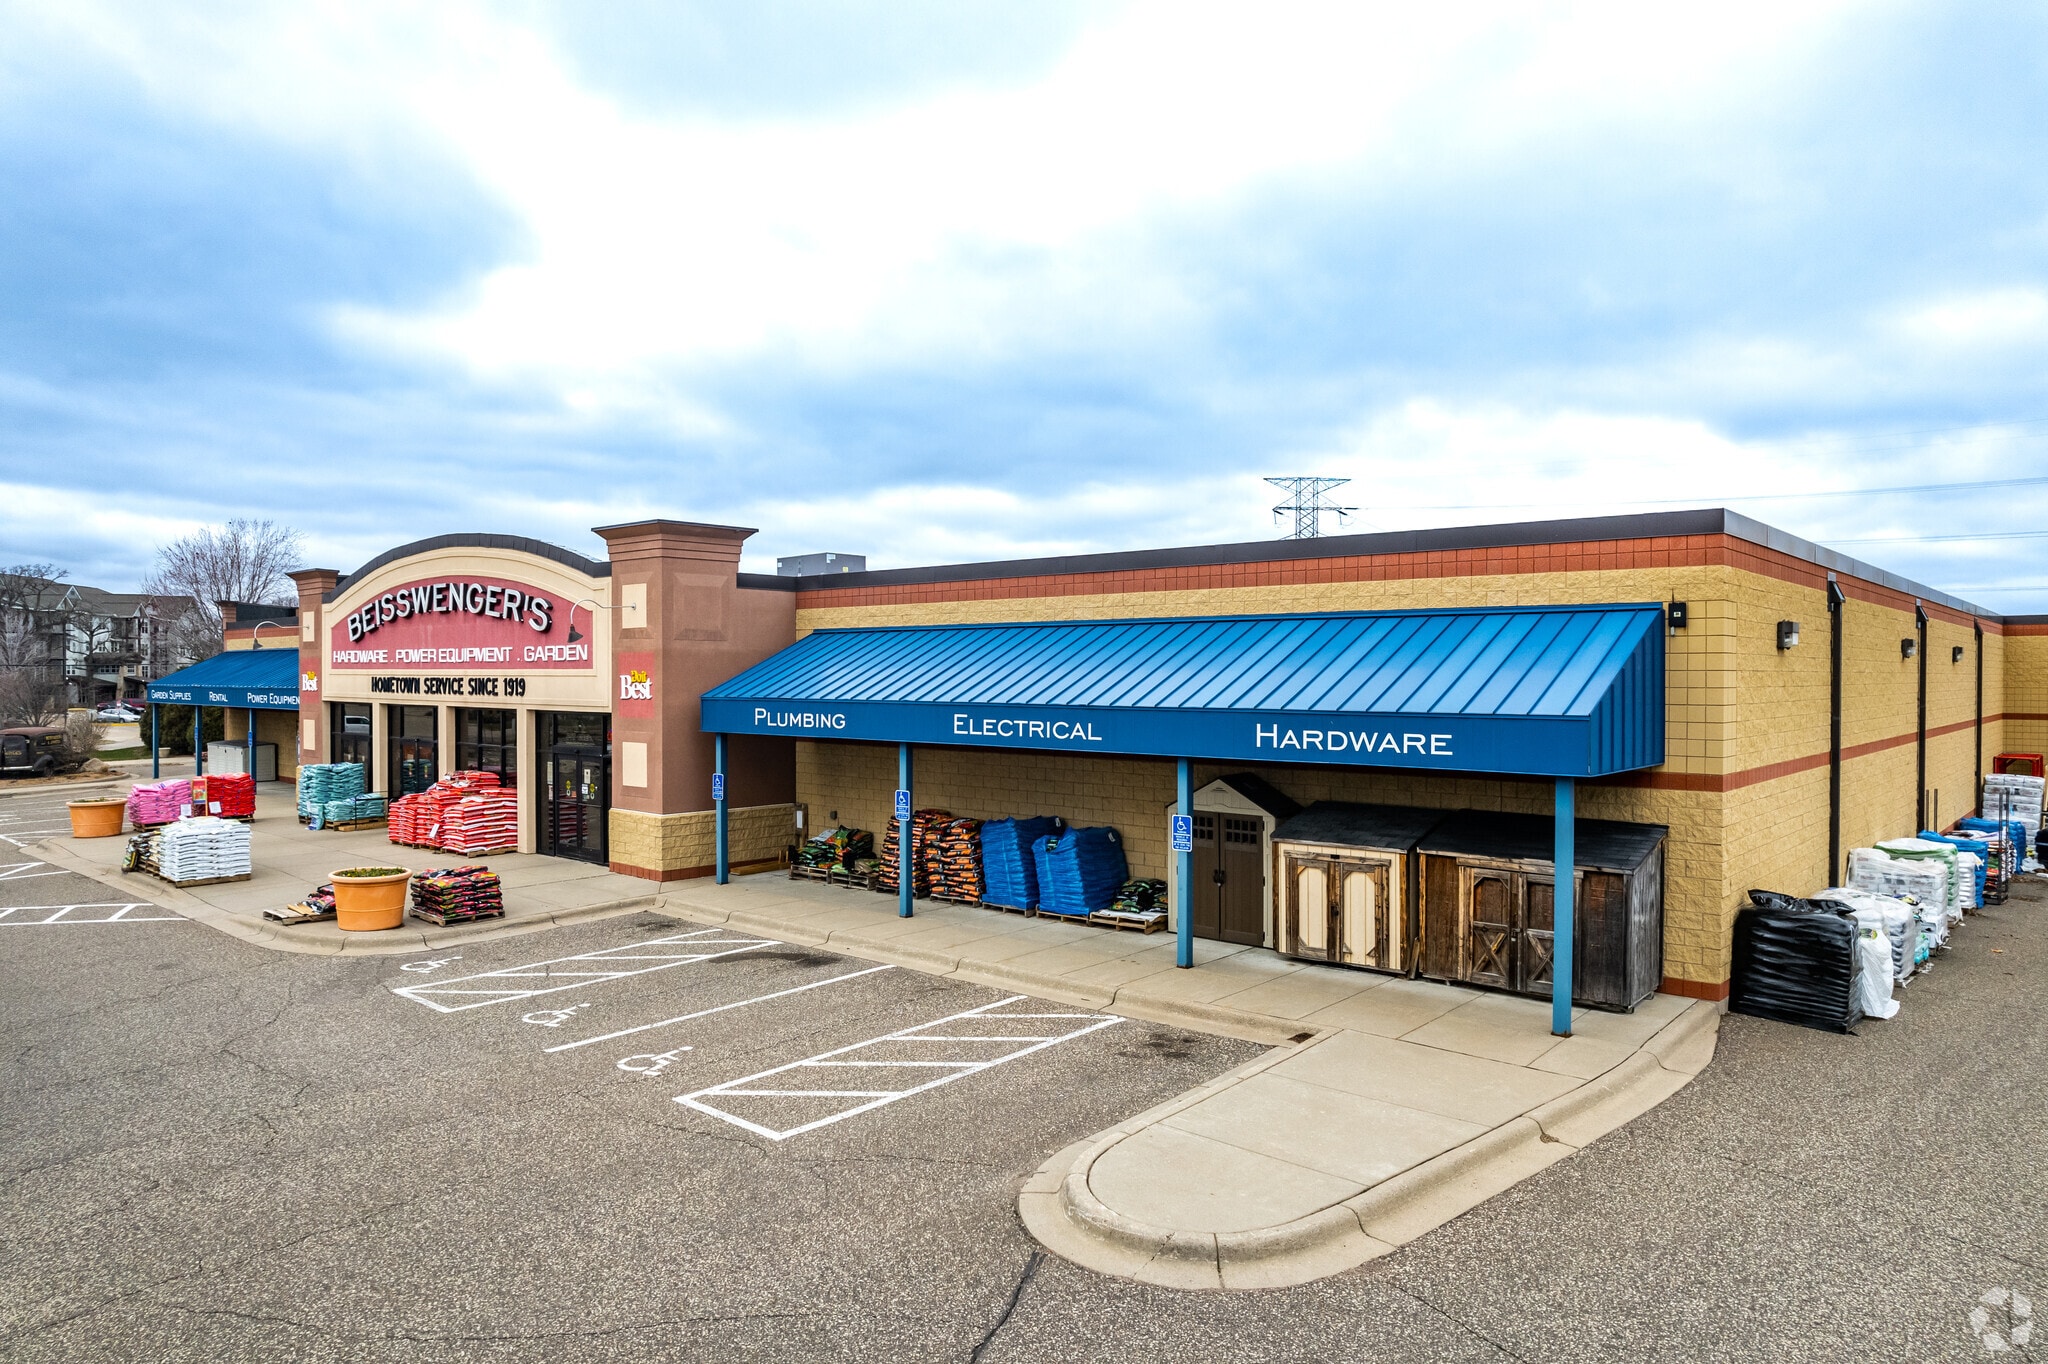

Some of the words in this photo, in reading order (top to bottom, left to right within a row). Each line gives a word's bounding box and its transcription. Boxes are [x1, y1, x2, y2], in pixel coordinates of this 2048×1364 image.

[347, 583, 551, 641] BEISSWENGER'S
[333, 650, 388, 663] HARDWARE
[396, 648, 437, 663] POWER
[438, 647, 513, 663] EQUIPMENT
[523, 644, 588, 662] GARDEN
[209, 691, 228, 702] RENTAL
[371, 676, 421, 694] HOMETOWN
[424, 677, 464, 696] SERVICE
[468, 677, 499, 697] SINCE
[503, 677, 526, 697] 1919
[620, 674, 653, 700] Best
[247, 692, 268, 704] POWER
[269, 692, 300, 705] EQUIPMEN
[754, 707, 846, 730] PLUMBING
[953, 714, 1103, 741] ELECTRICAL
[1256, 723, 1453, 756] HARDWARE
